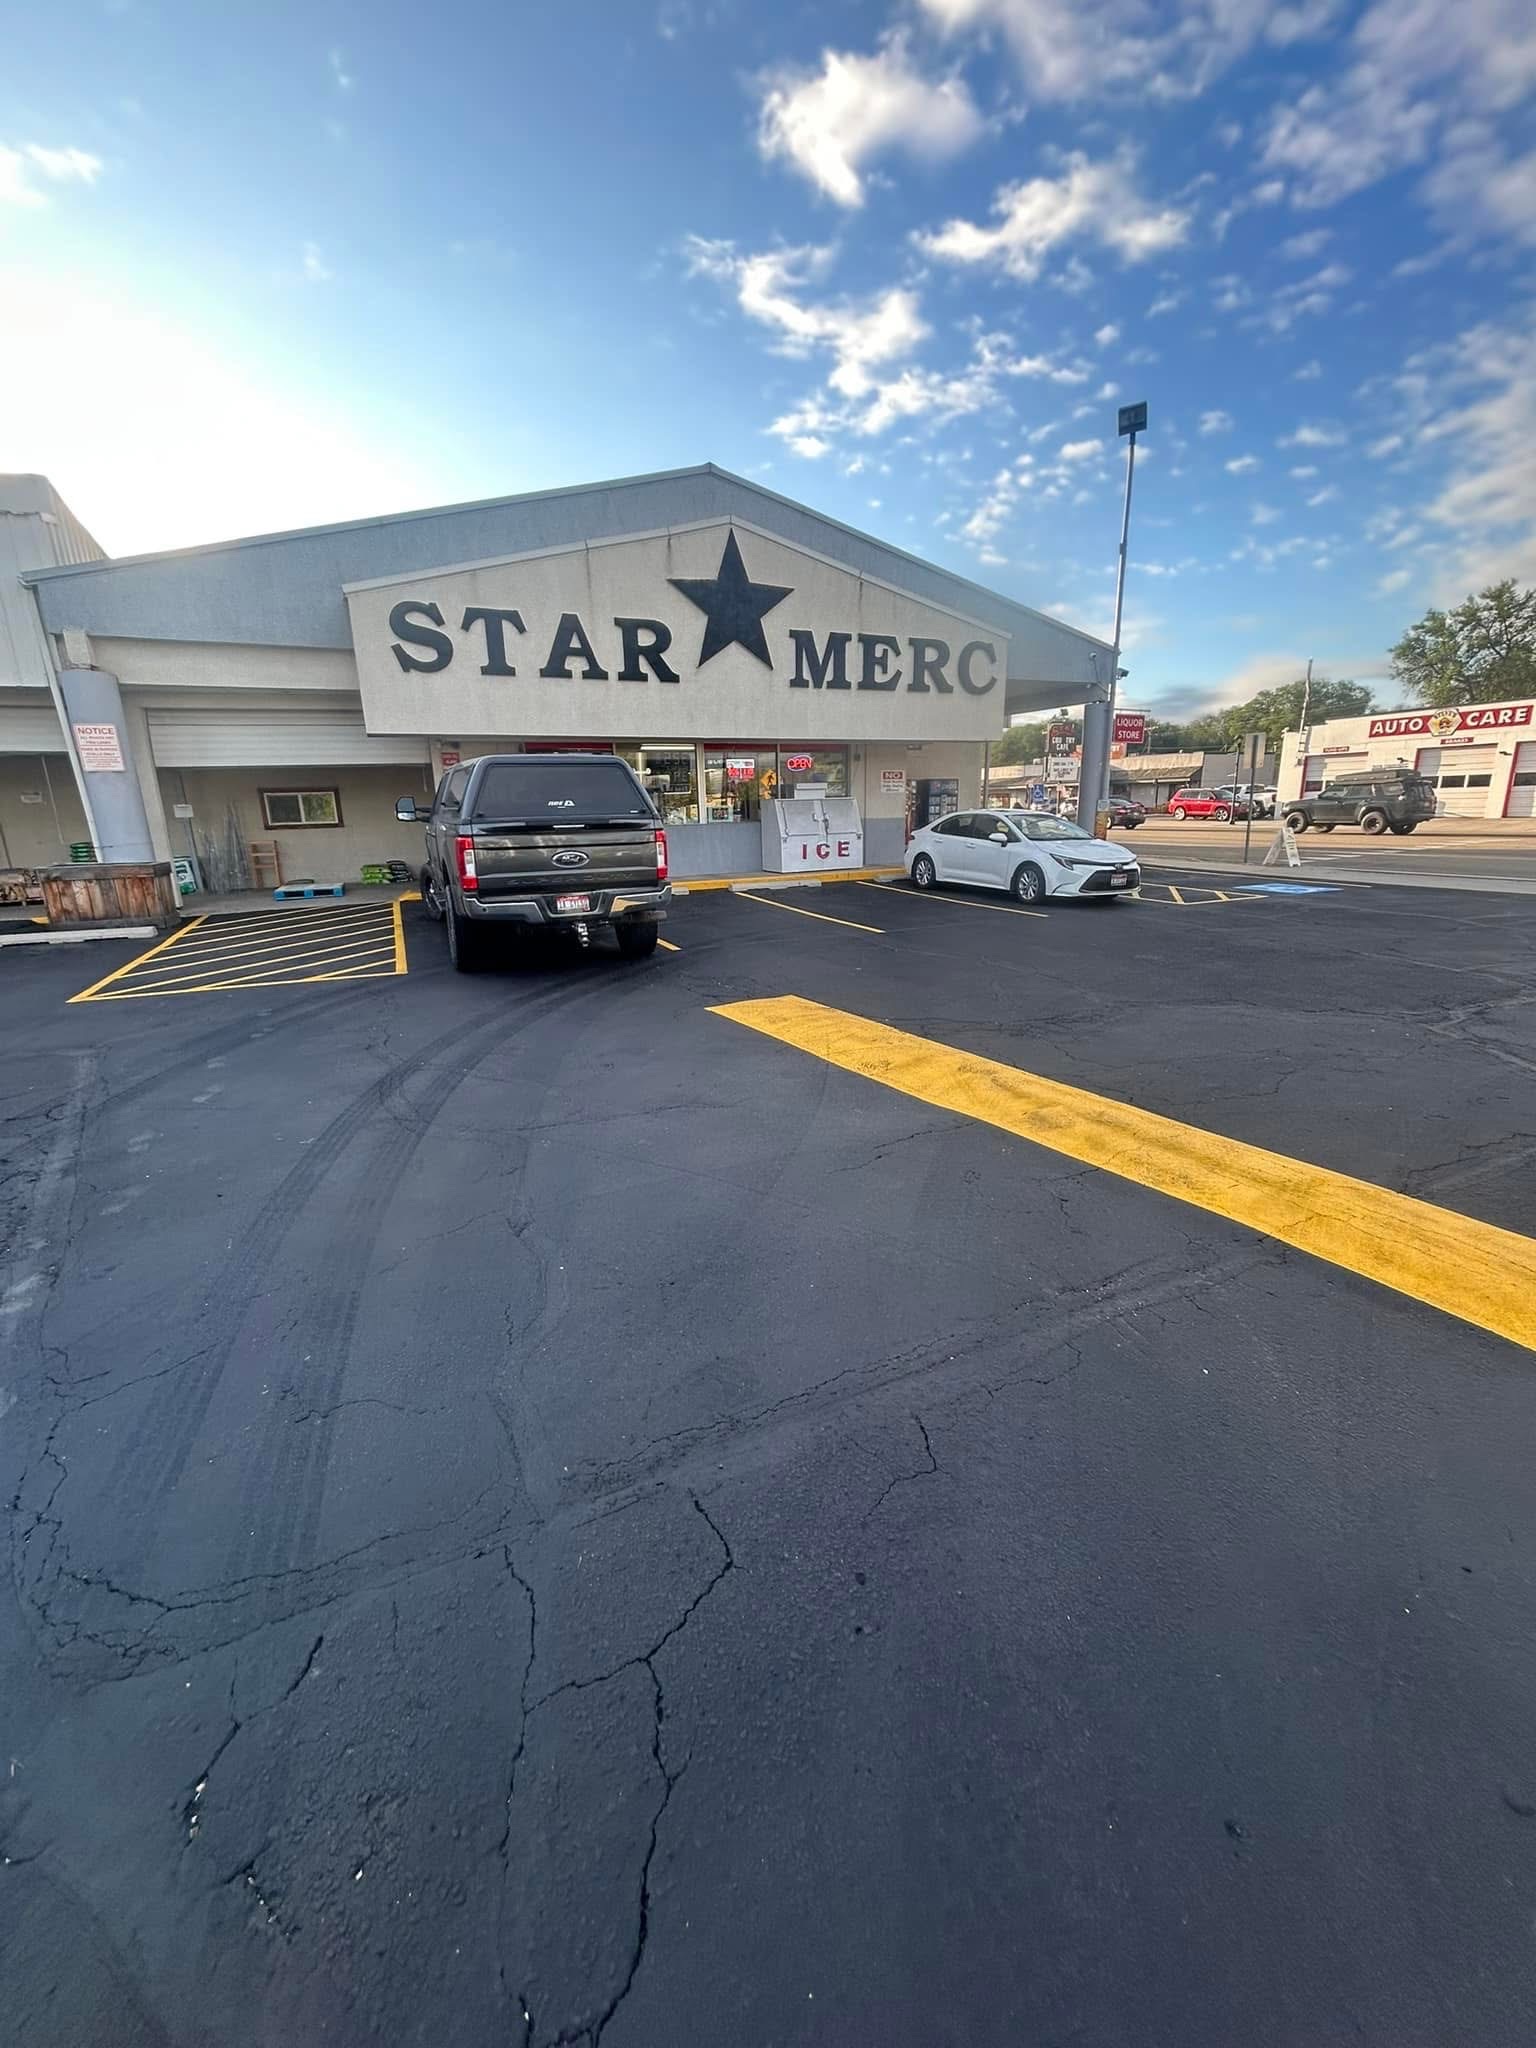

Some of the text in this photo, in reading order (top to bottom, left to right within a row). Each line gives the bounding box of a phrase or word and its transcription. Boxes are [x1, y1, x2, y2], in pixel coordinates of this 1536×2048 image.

[388, 600, 680, 684] STAR
[789, 628, 998, 696] MERC
[1117, 718, 1143, 728] LIQUOR
[1371, 707, 1528, 734] AUTO CARE
[78, 727, 115, 735] NOTICE
[1118, 730, 1140, 739] STORE
[787, 757, 812, 769] OPEN
[801, 841, 850, 860] ICE
